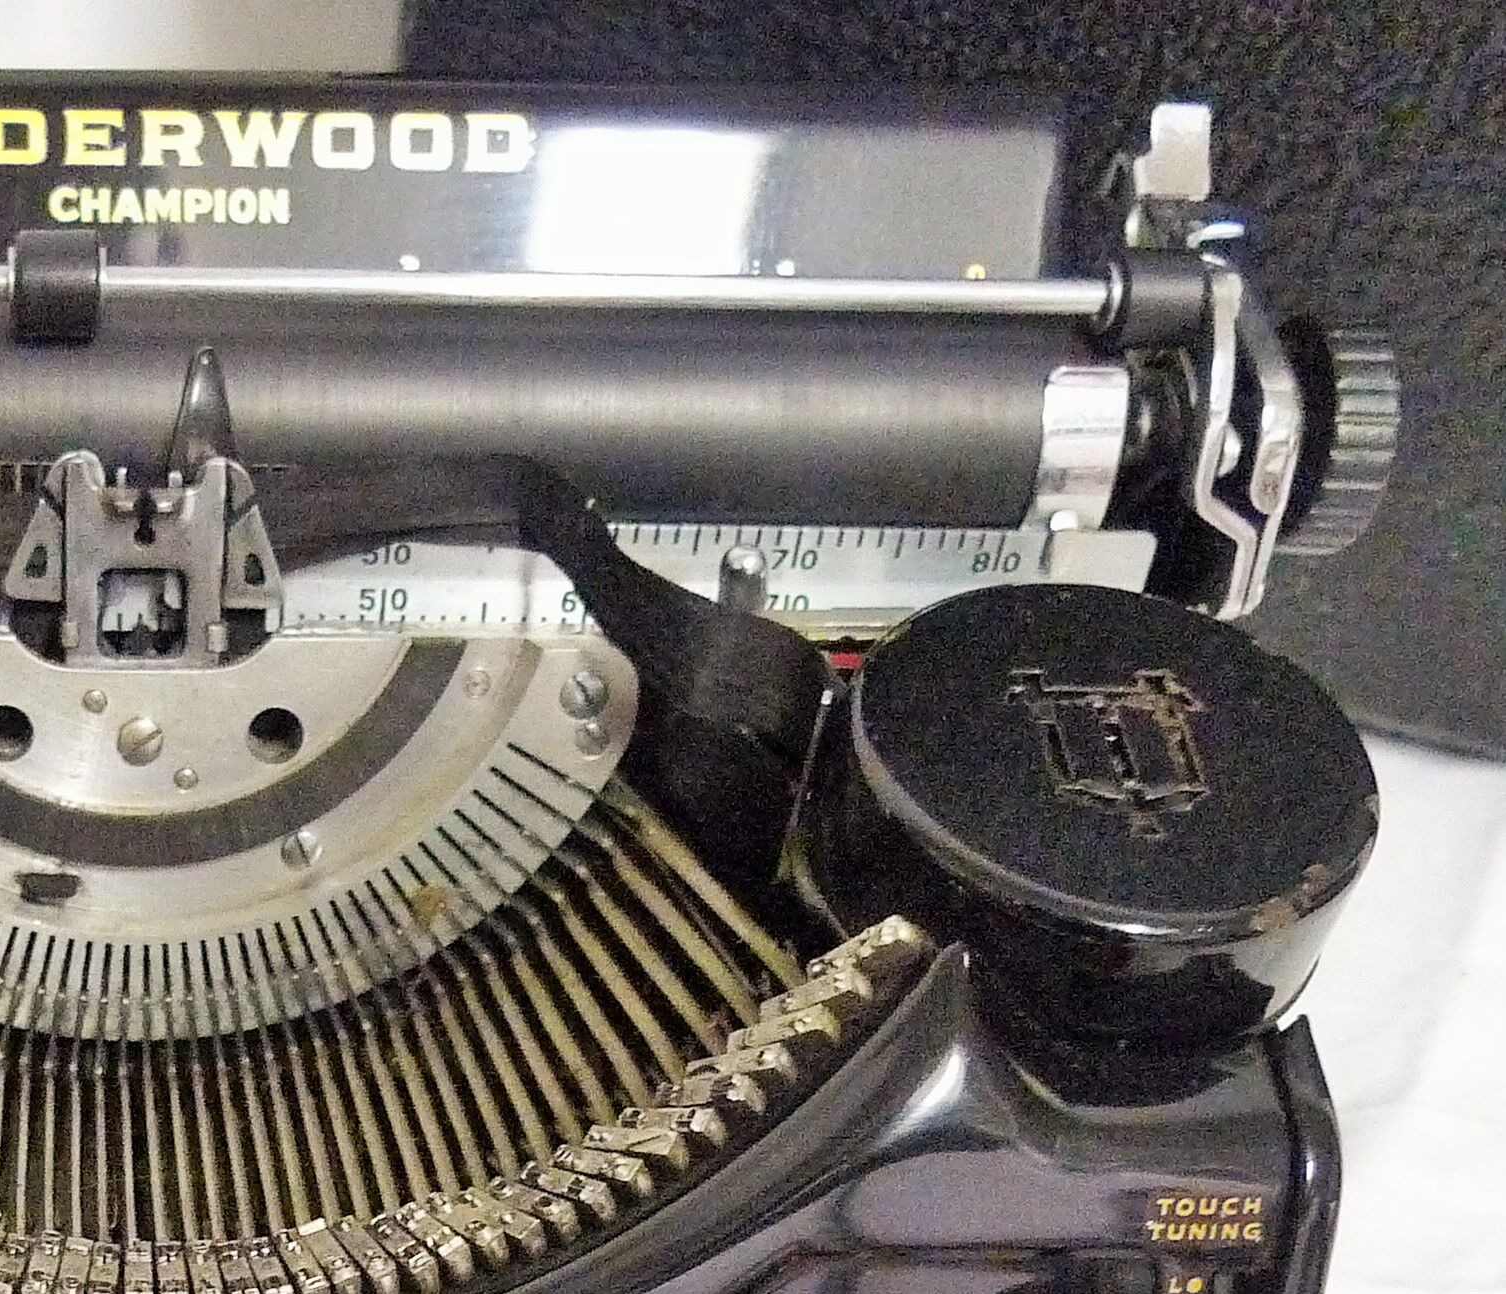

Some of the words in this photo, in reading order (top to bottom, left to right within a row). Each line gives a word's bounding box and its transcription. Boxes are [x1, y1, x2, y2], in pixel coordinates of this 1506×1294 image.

[48, 186, 291, 225] CHAMPION
[1156, 1197, 1263, 1217] TOUCH
[1147, 1221, 1263, 1241] TUNING
